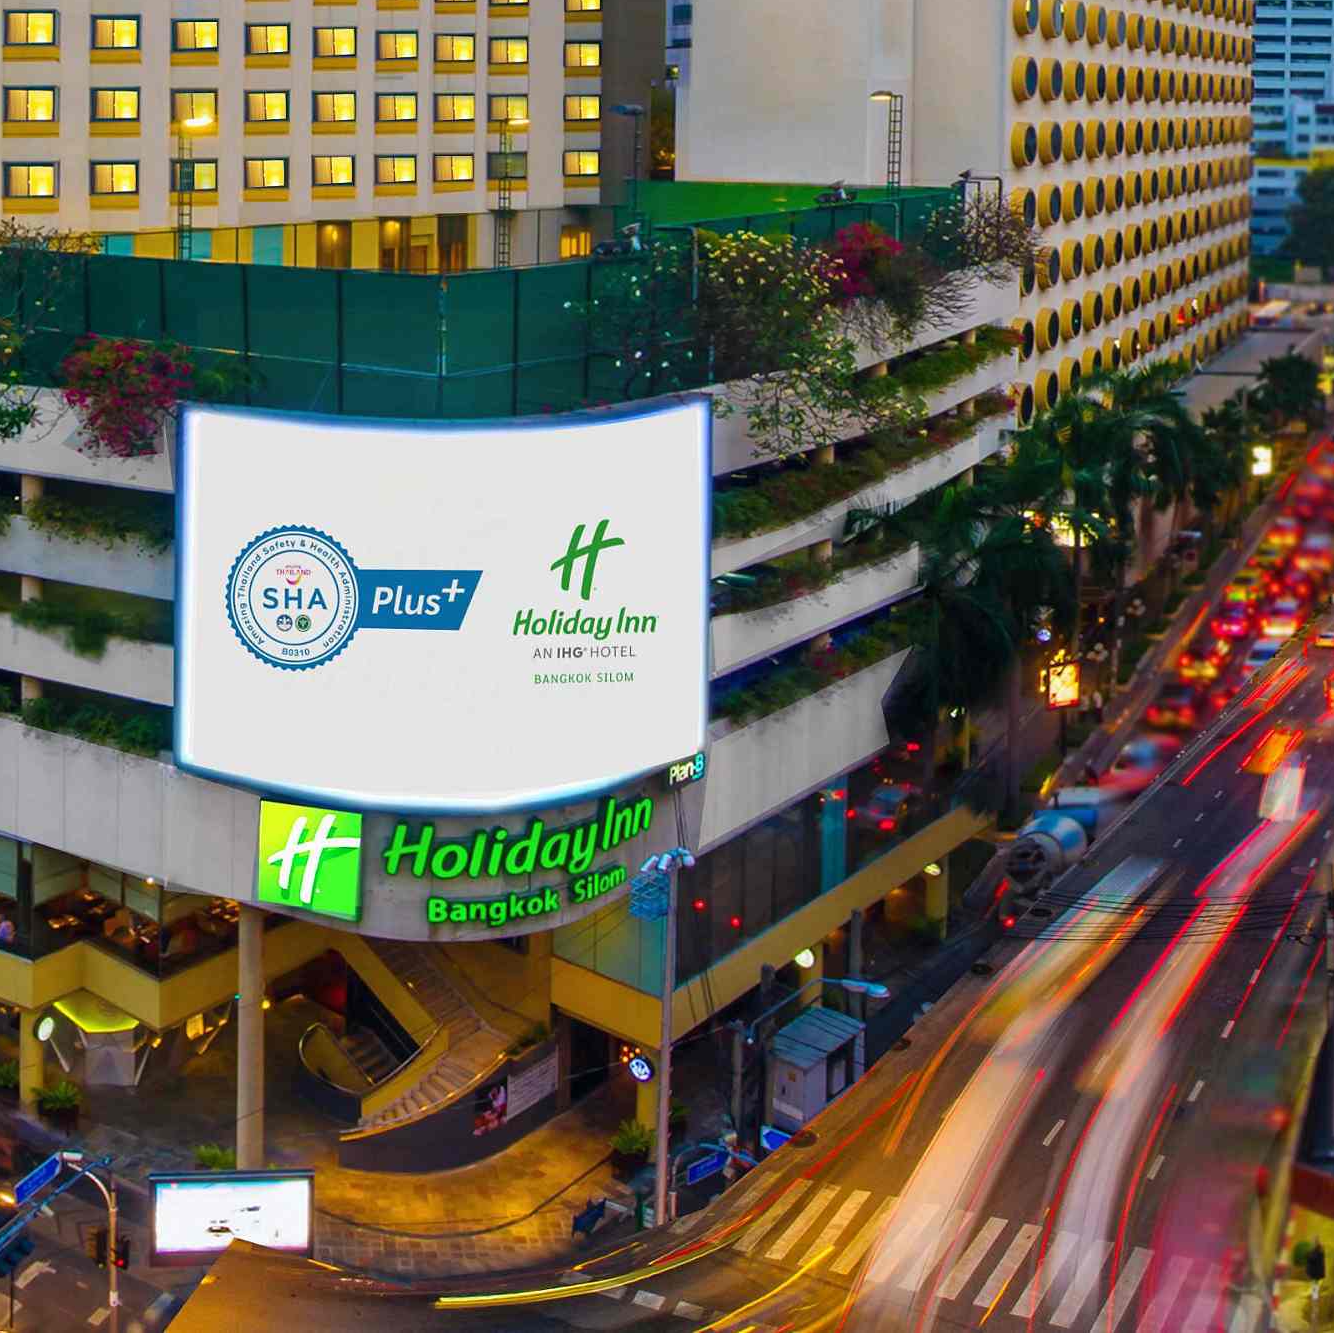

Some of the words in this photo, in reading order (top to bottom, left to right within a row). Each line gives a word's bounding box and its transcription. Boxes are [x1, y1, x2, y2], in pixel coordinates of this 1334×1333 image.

[262, 587, 328, 610] SHA
[512, 607, 613, 641] Holiday
[615, 606, 657, 634] Inn
[533, 647, 553, 659] AN
[590, 645, 637, 658] HOTEL
[533, 672, 592, 685] BANGKOK
[596, 671, 635, 683] SILOM
[382, 817, 599, 880] Holiday
[601, 796, 654, 852] Inn
[427, 887, 562, 927] Bangkok
[573, 864, 627, 904] Silom
